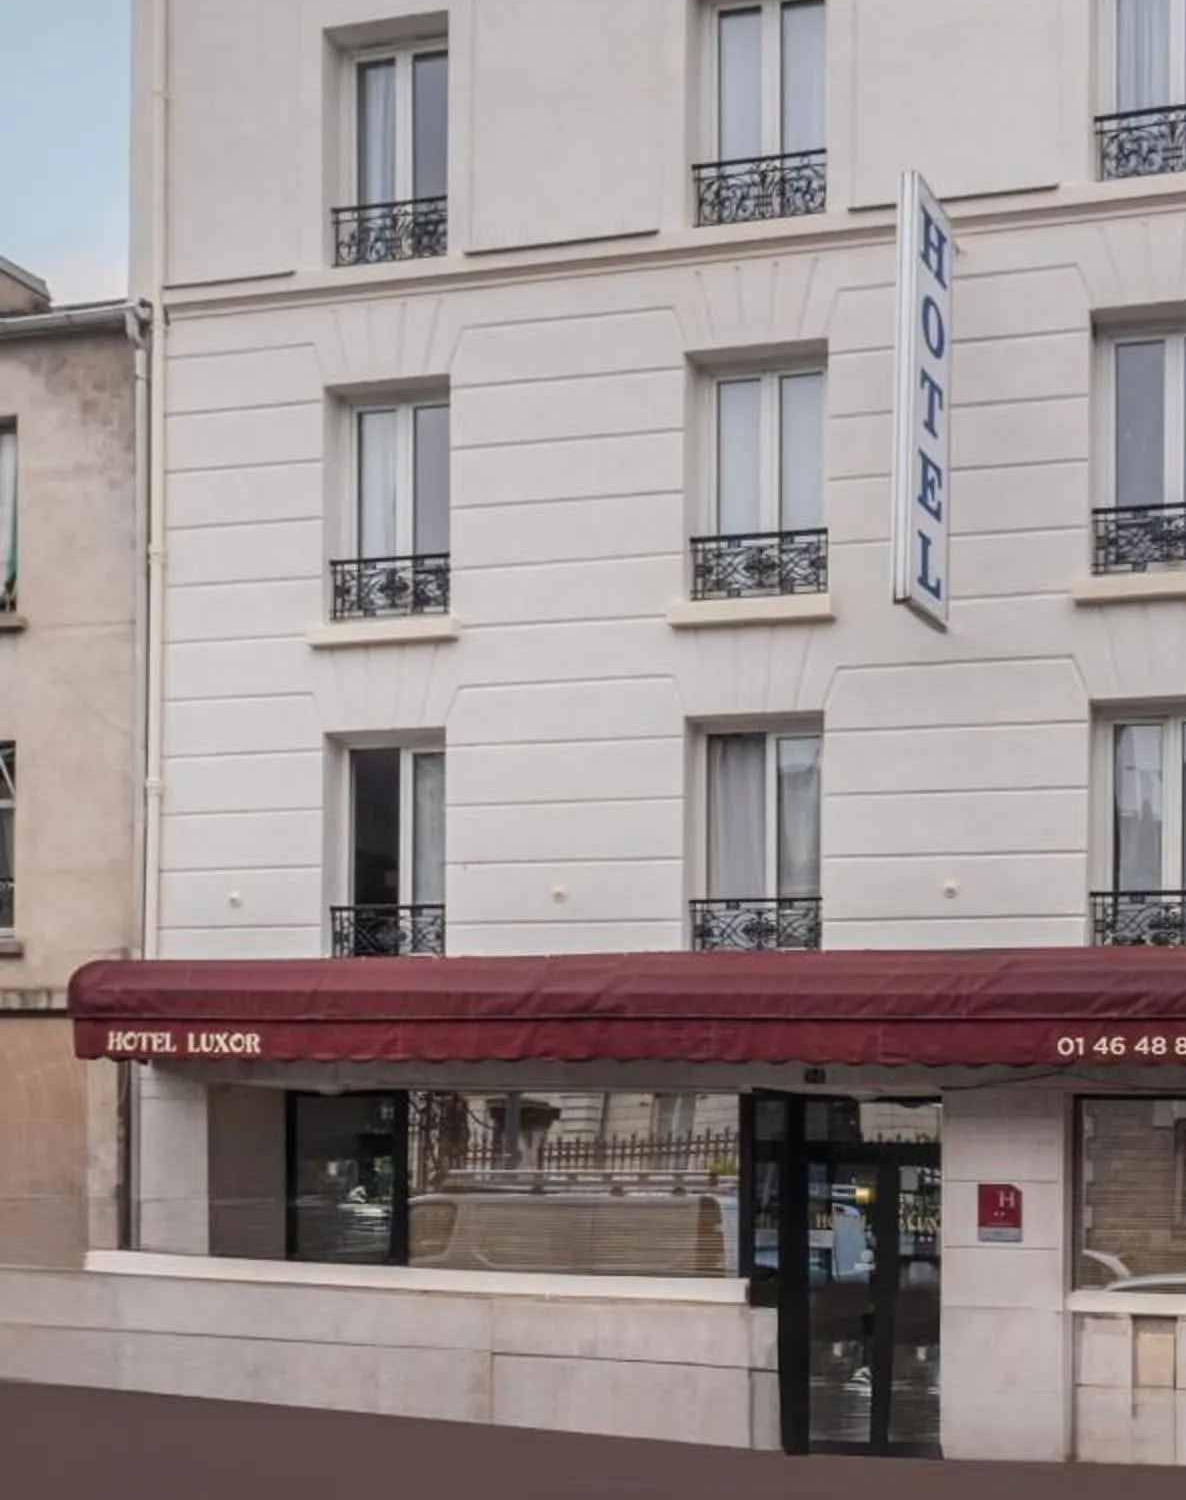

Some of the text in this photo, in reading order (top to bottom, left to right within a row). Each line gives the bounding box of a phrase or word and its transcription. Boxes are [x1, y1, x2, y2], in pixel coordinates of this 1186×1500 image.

[917, 204, 948, 600] HOTEL
[107, 1031, 261, 1053] HOTEL LUXOR
[1057, 1037, 1084, 1055] 01
[1093, 1036, 1125, 1055] 46
[1134, 1036, 1167, 1055] 48
[998, 1190, 1016, 1209] H
